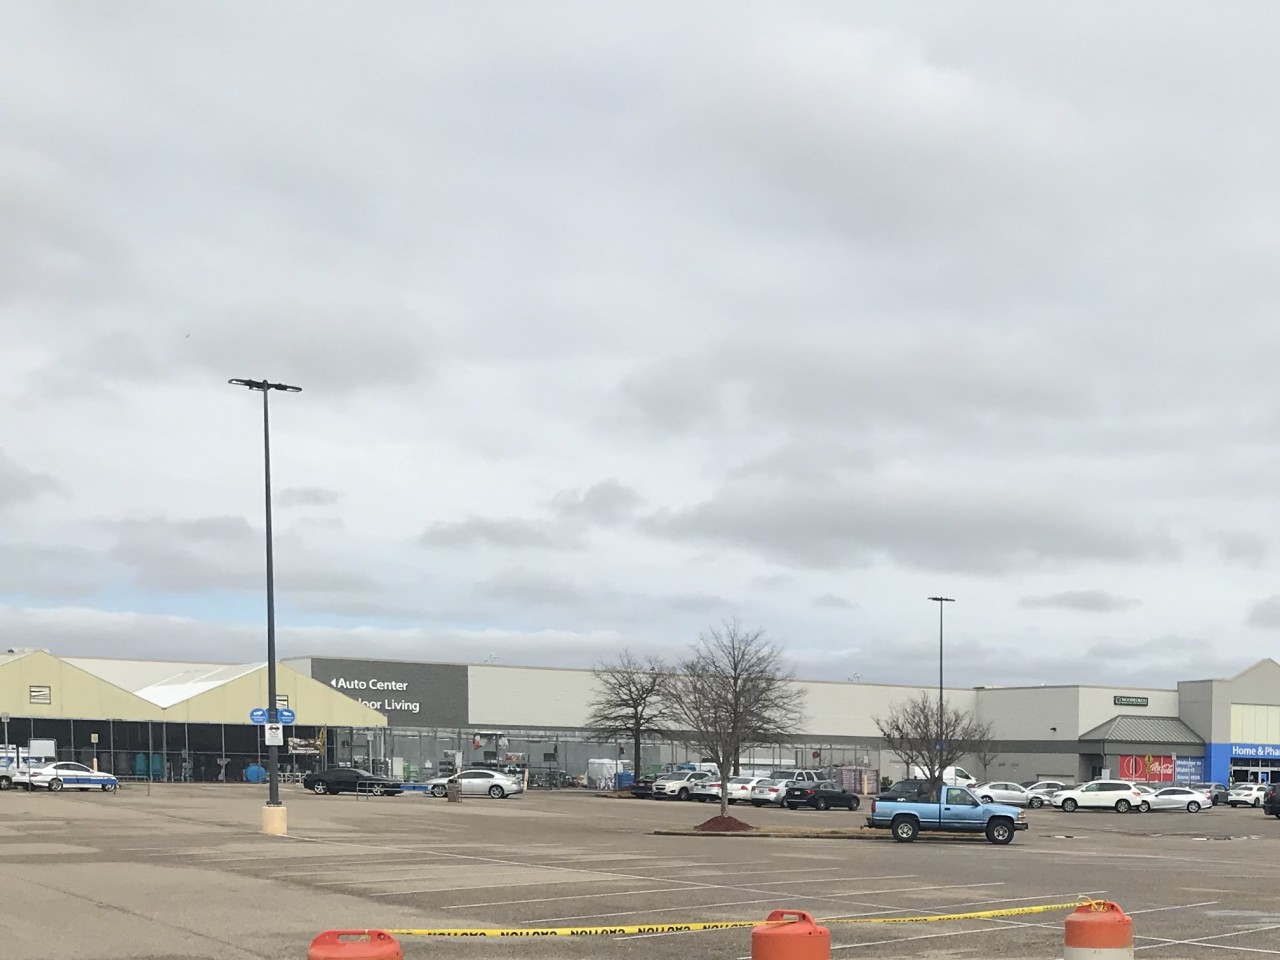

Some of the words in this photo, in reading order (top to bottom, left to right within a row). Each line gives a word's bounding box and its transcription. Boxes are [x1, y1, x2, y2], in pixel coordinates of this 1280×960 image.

[338, 678, 367, 689] Auto
[369, 679, 408, 691] Center
[385, 699, 420, 713] Living
[1232, 746, 1256, 755] Home
[1258, 746, 1264, 755] &
